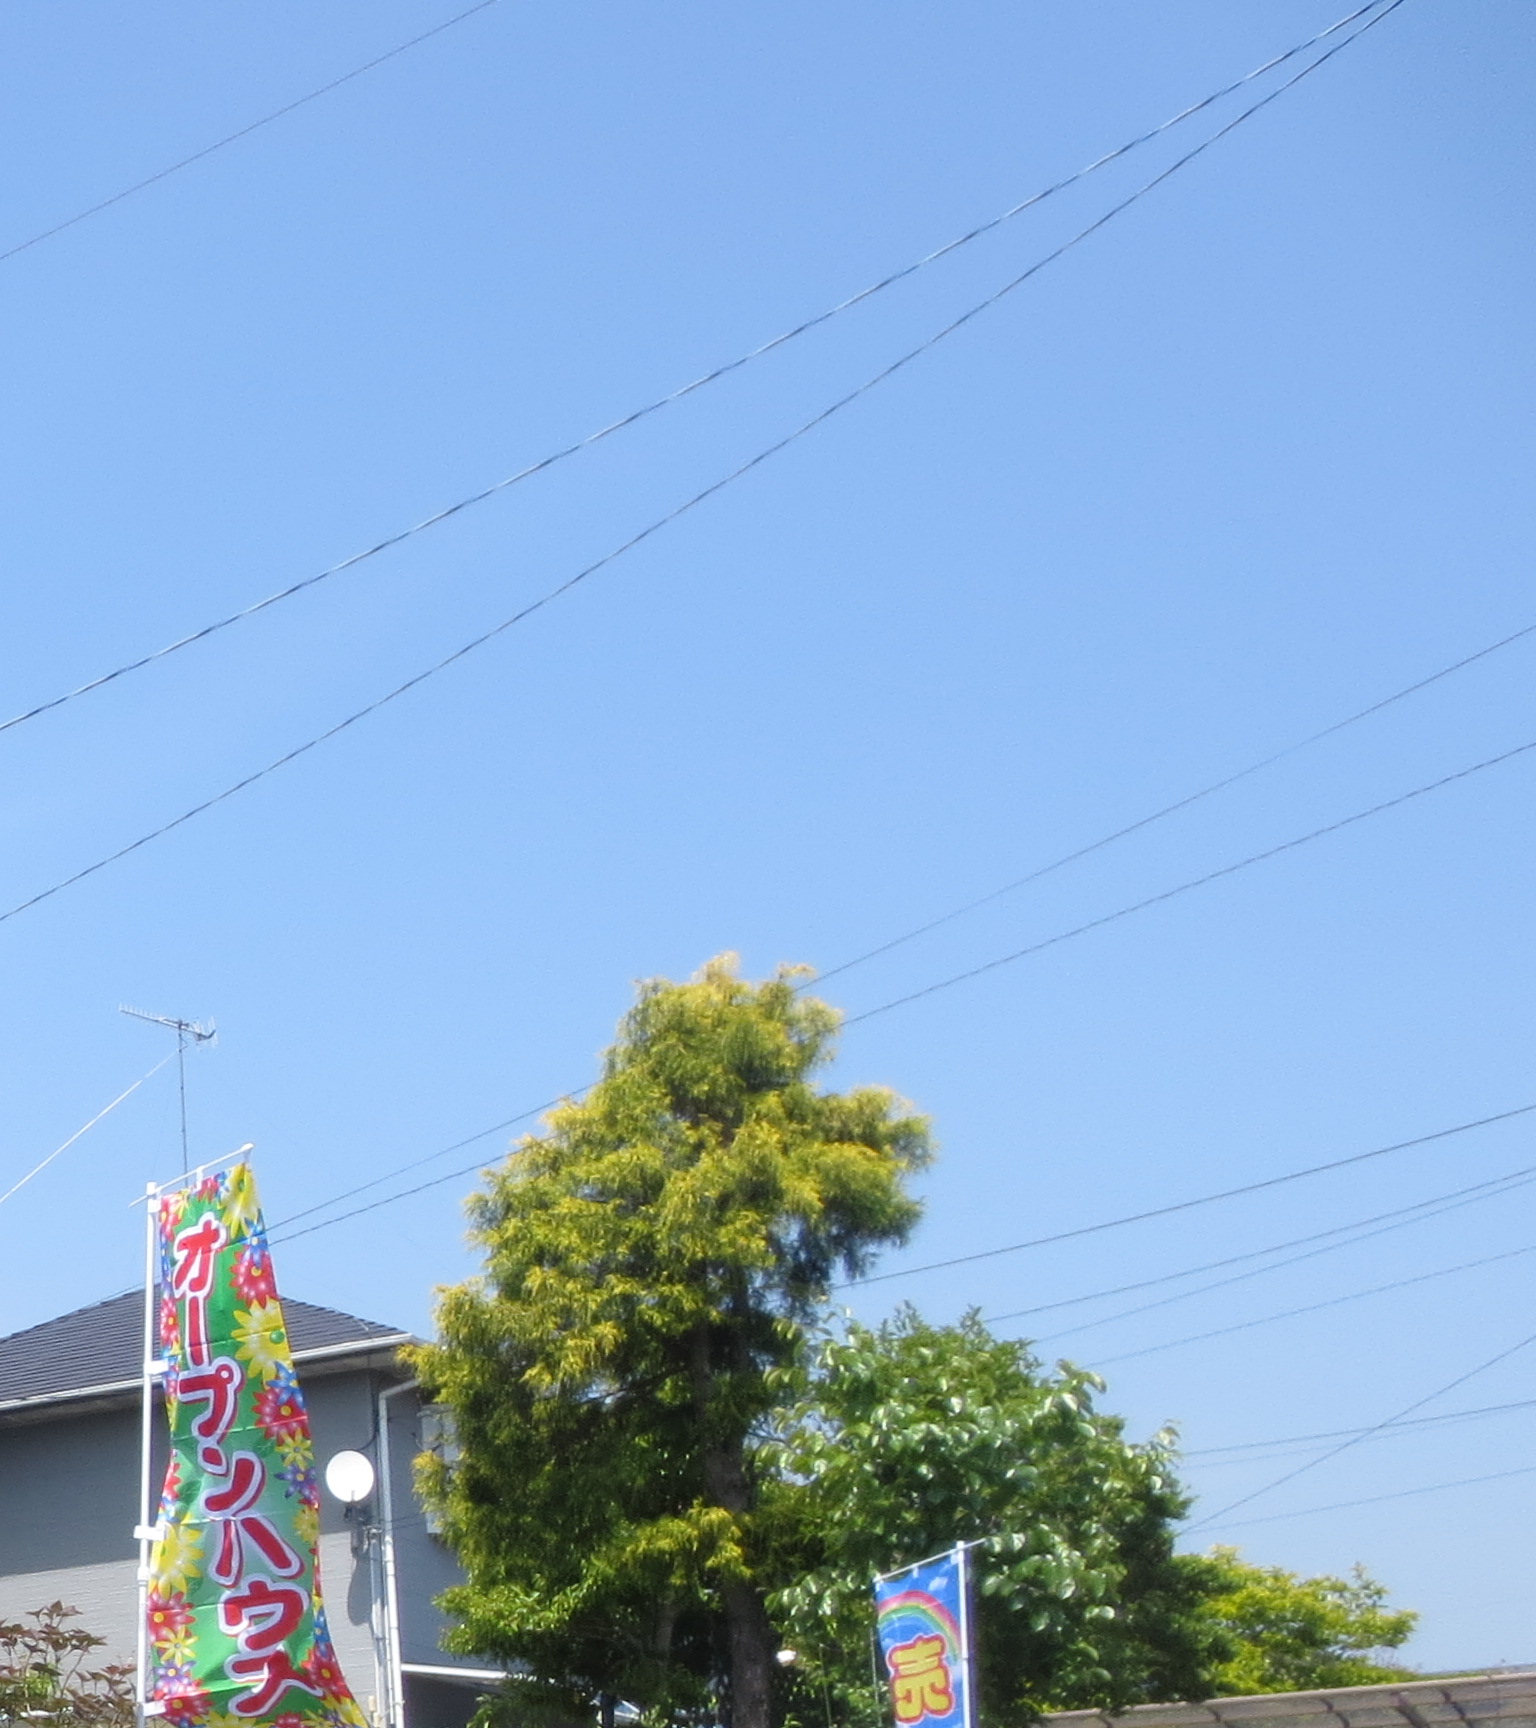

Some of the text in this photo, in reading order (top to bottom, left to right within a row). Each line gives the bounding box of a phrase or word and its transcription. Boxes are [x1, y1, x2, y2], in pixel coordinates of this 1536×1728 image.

[174, 1212, 323, 1718] オープンハウス
